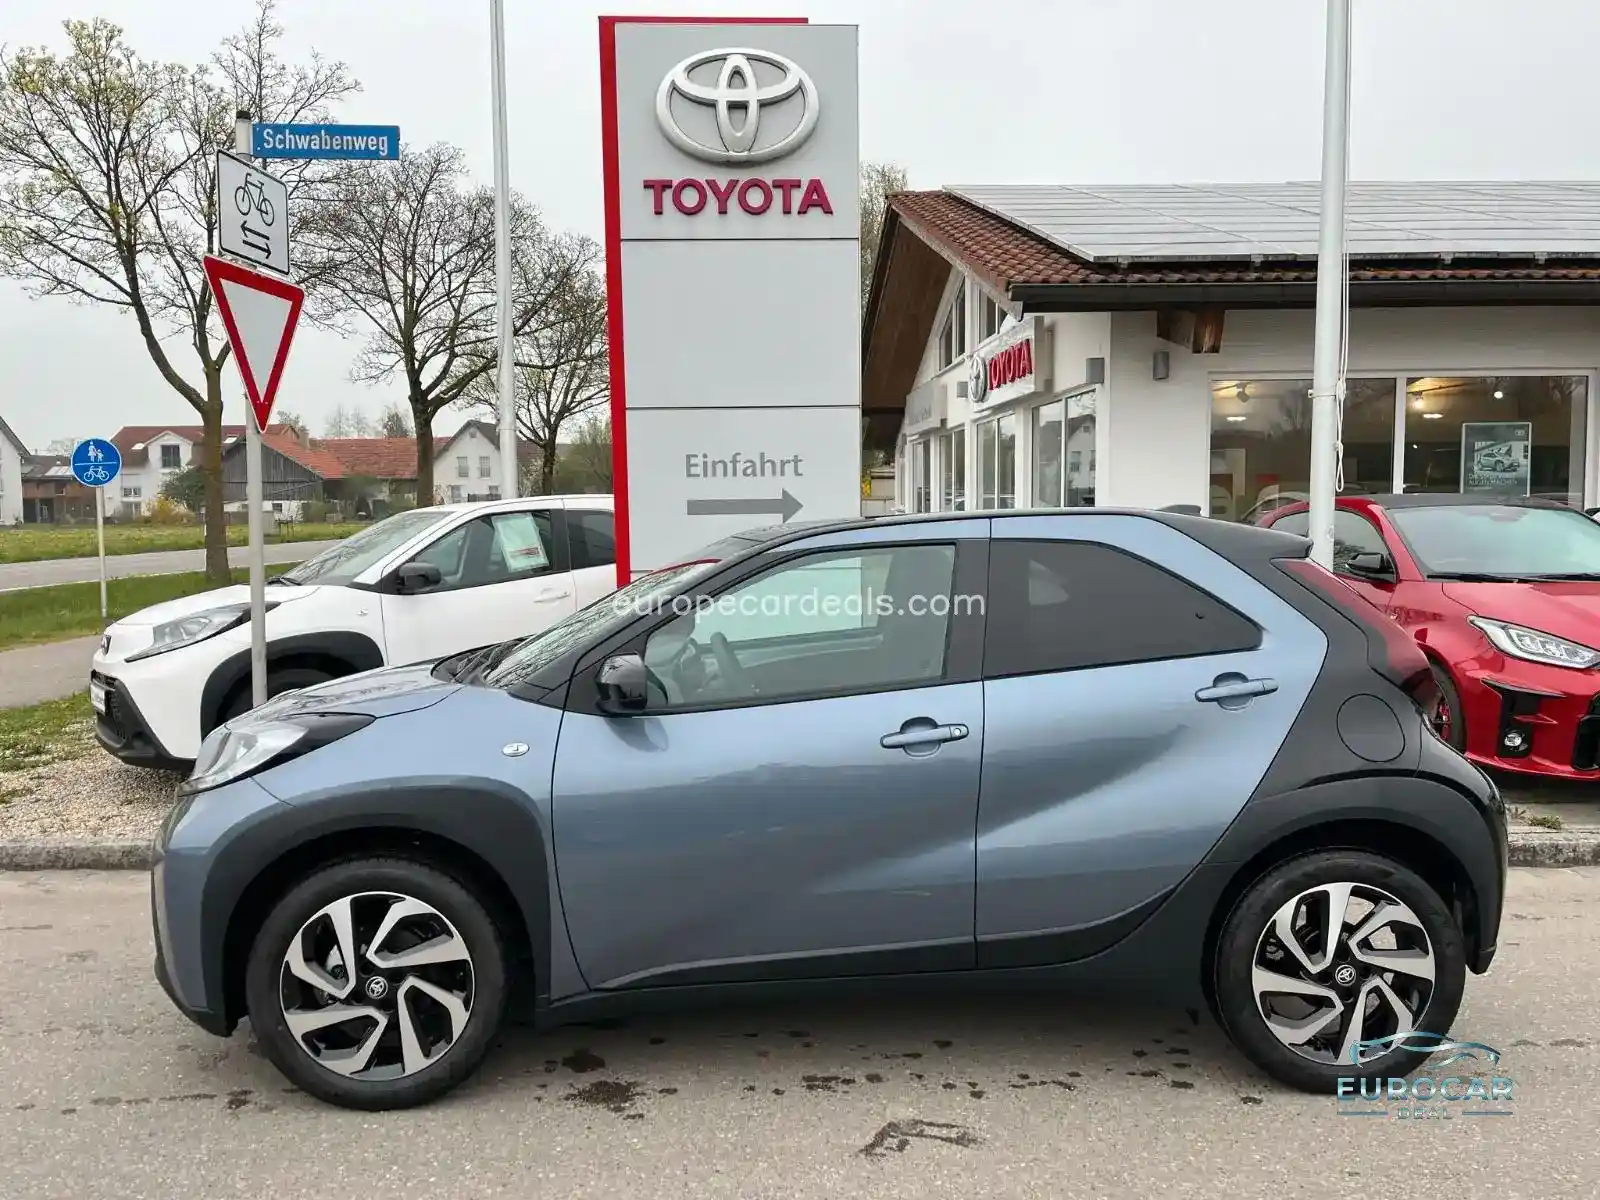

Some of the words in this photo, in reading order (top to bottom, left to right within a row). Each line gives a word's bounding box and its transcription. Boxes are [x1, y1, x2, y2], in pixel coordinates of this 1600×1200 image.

[263, 128, 388, 156] Schwabenweg
[643, 178, 834, 215] TOYOTA
[987, 338, 1033, 391] TOYOTA
[685, 452, 804, 478] Einfahrt
